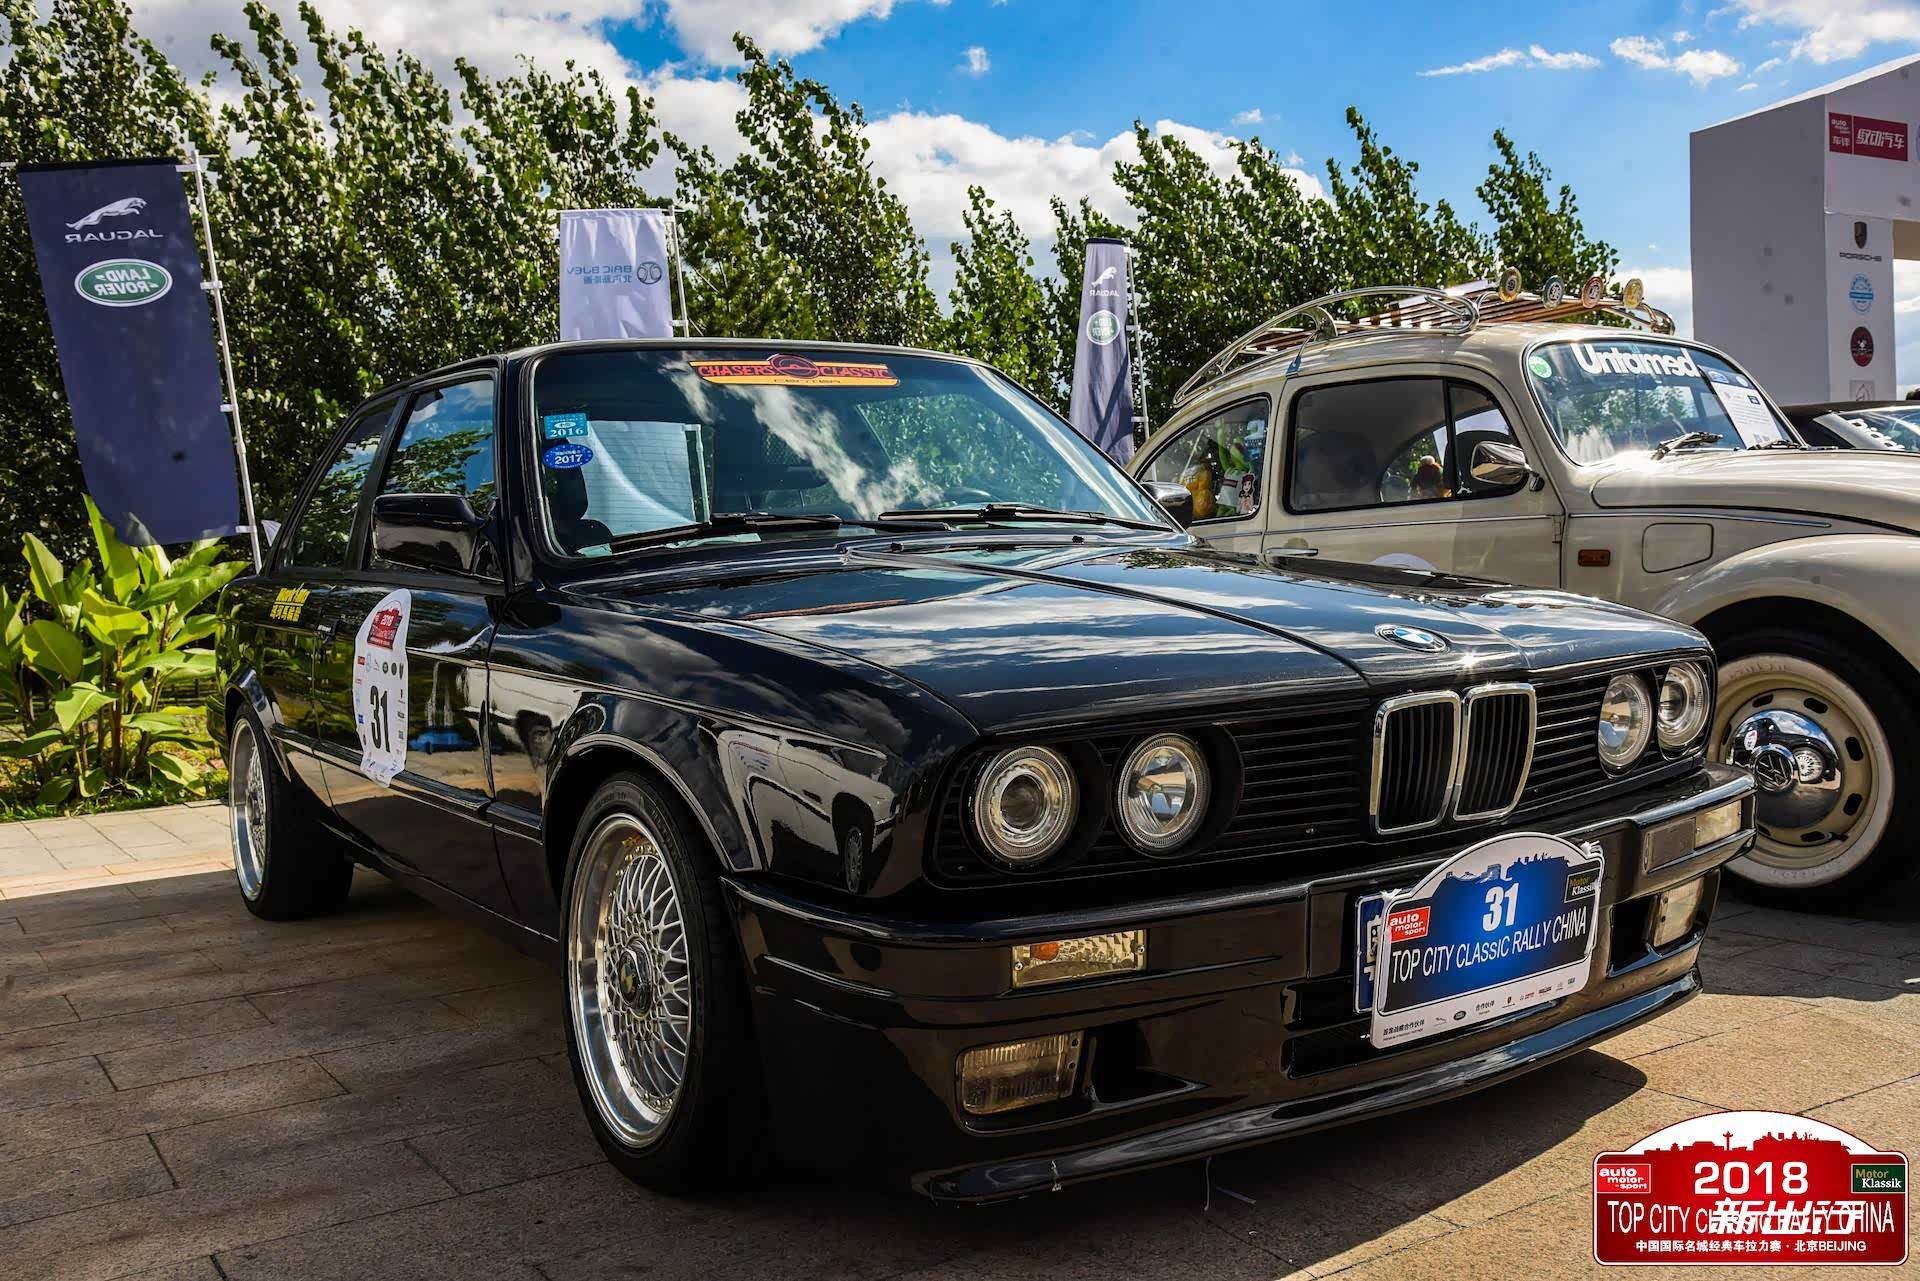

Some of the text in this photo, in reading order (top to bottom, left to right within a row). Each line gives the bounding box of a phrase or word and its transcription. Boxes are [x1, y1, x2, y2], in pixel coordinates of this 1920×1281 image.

[1570, 343, 1701, 378] Untamed
[698, 365, 889, 379] CHASERS CLASSIC
[550, 427, 584, 438] 2016
[554, 454, 583, 465] 2017
[369, 685, 391, 753] 31
[1482, 882, 1520, 932] 31
[1390, 913, 1420, 926] auto
[1395, 921, 1424, 932] motor
[1404, 926, 1426, 936] sport
[1392, 950, 1421, 983] TOP
[1422, 944, 1455, 977] CITY
[1456, 935, 1510, 968] CLASSIC
[1512, 919, 1552, 953] RALLY
[1551, 906, 1587, 942] CHINA
